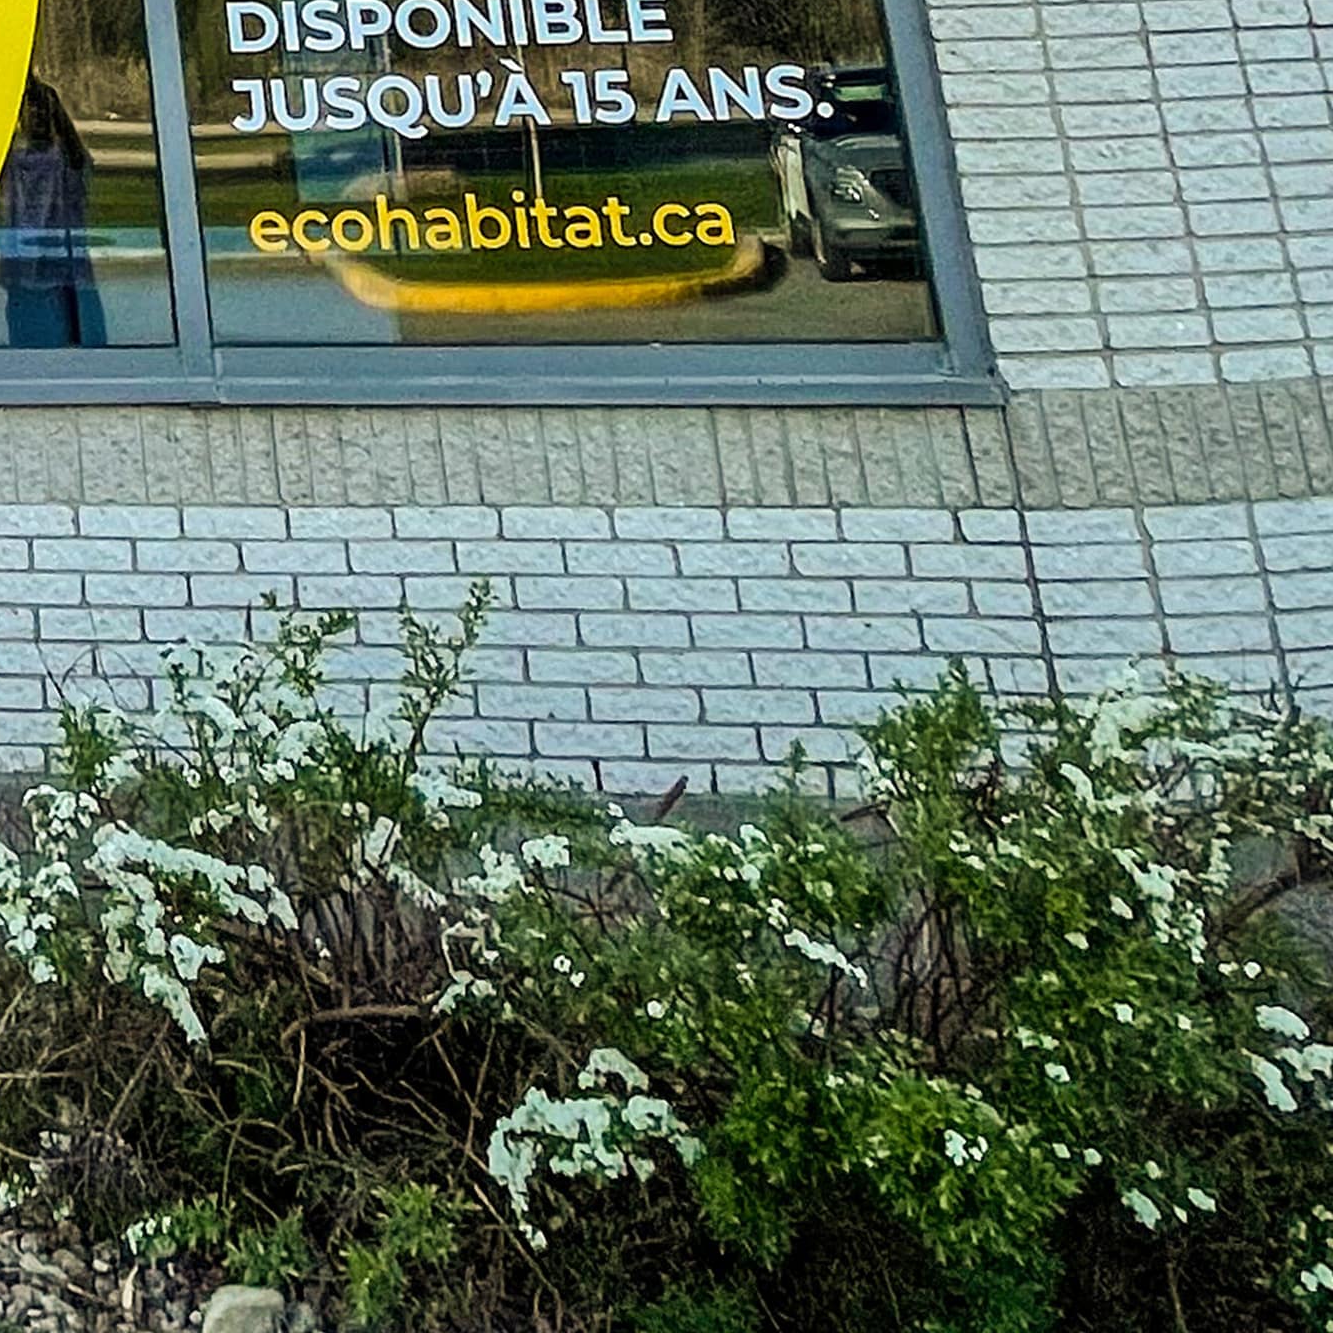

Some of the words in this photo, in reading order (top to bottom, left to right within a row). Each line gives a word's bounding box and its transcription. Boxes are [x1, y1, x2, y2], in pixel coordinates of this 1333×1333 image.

[231, 59, 552, 139] JUSQU'À
[562, 68, 636, 126] 15
[656, 64, 835, 123] ANS.
[248, 189, 737, 254] ecohabitat.ca
